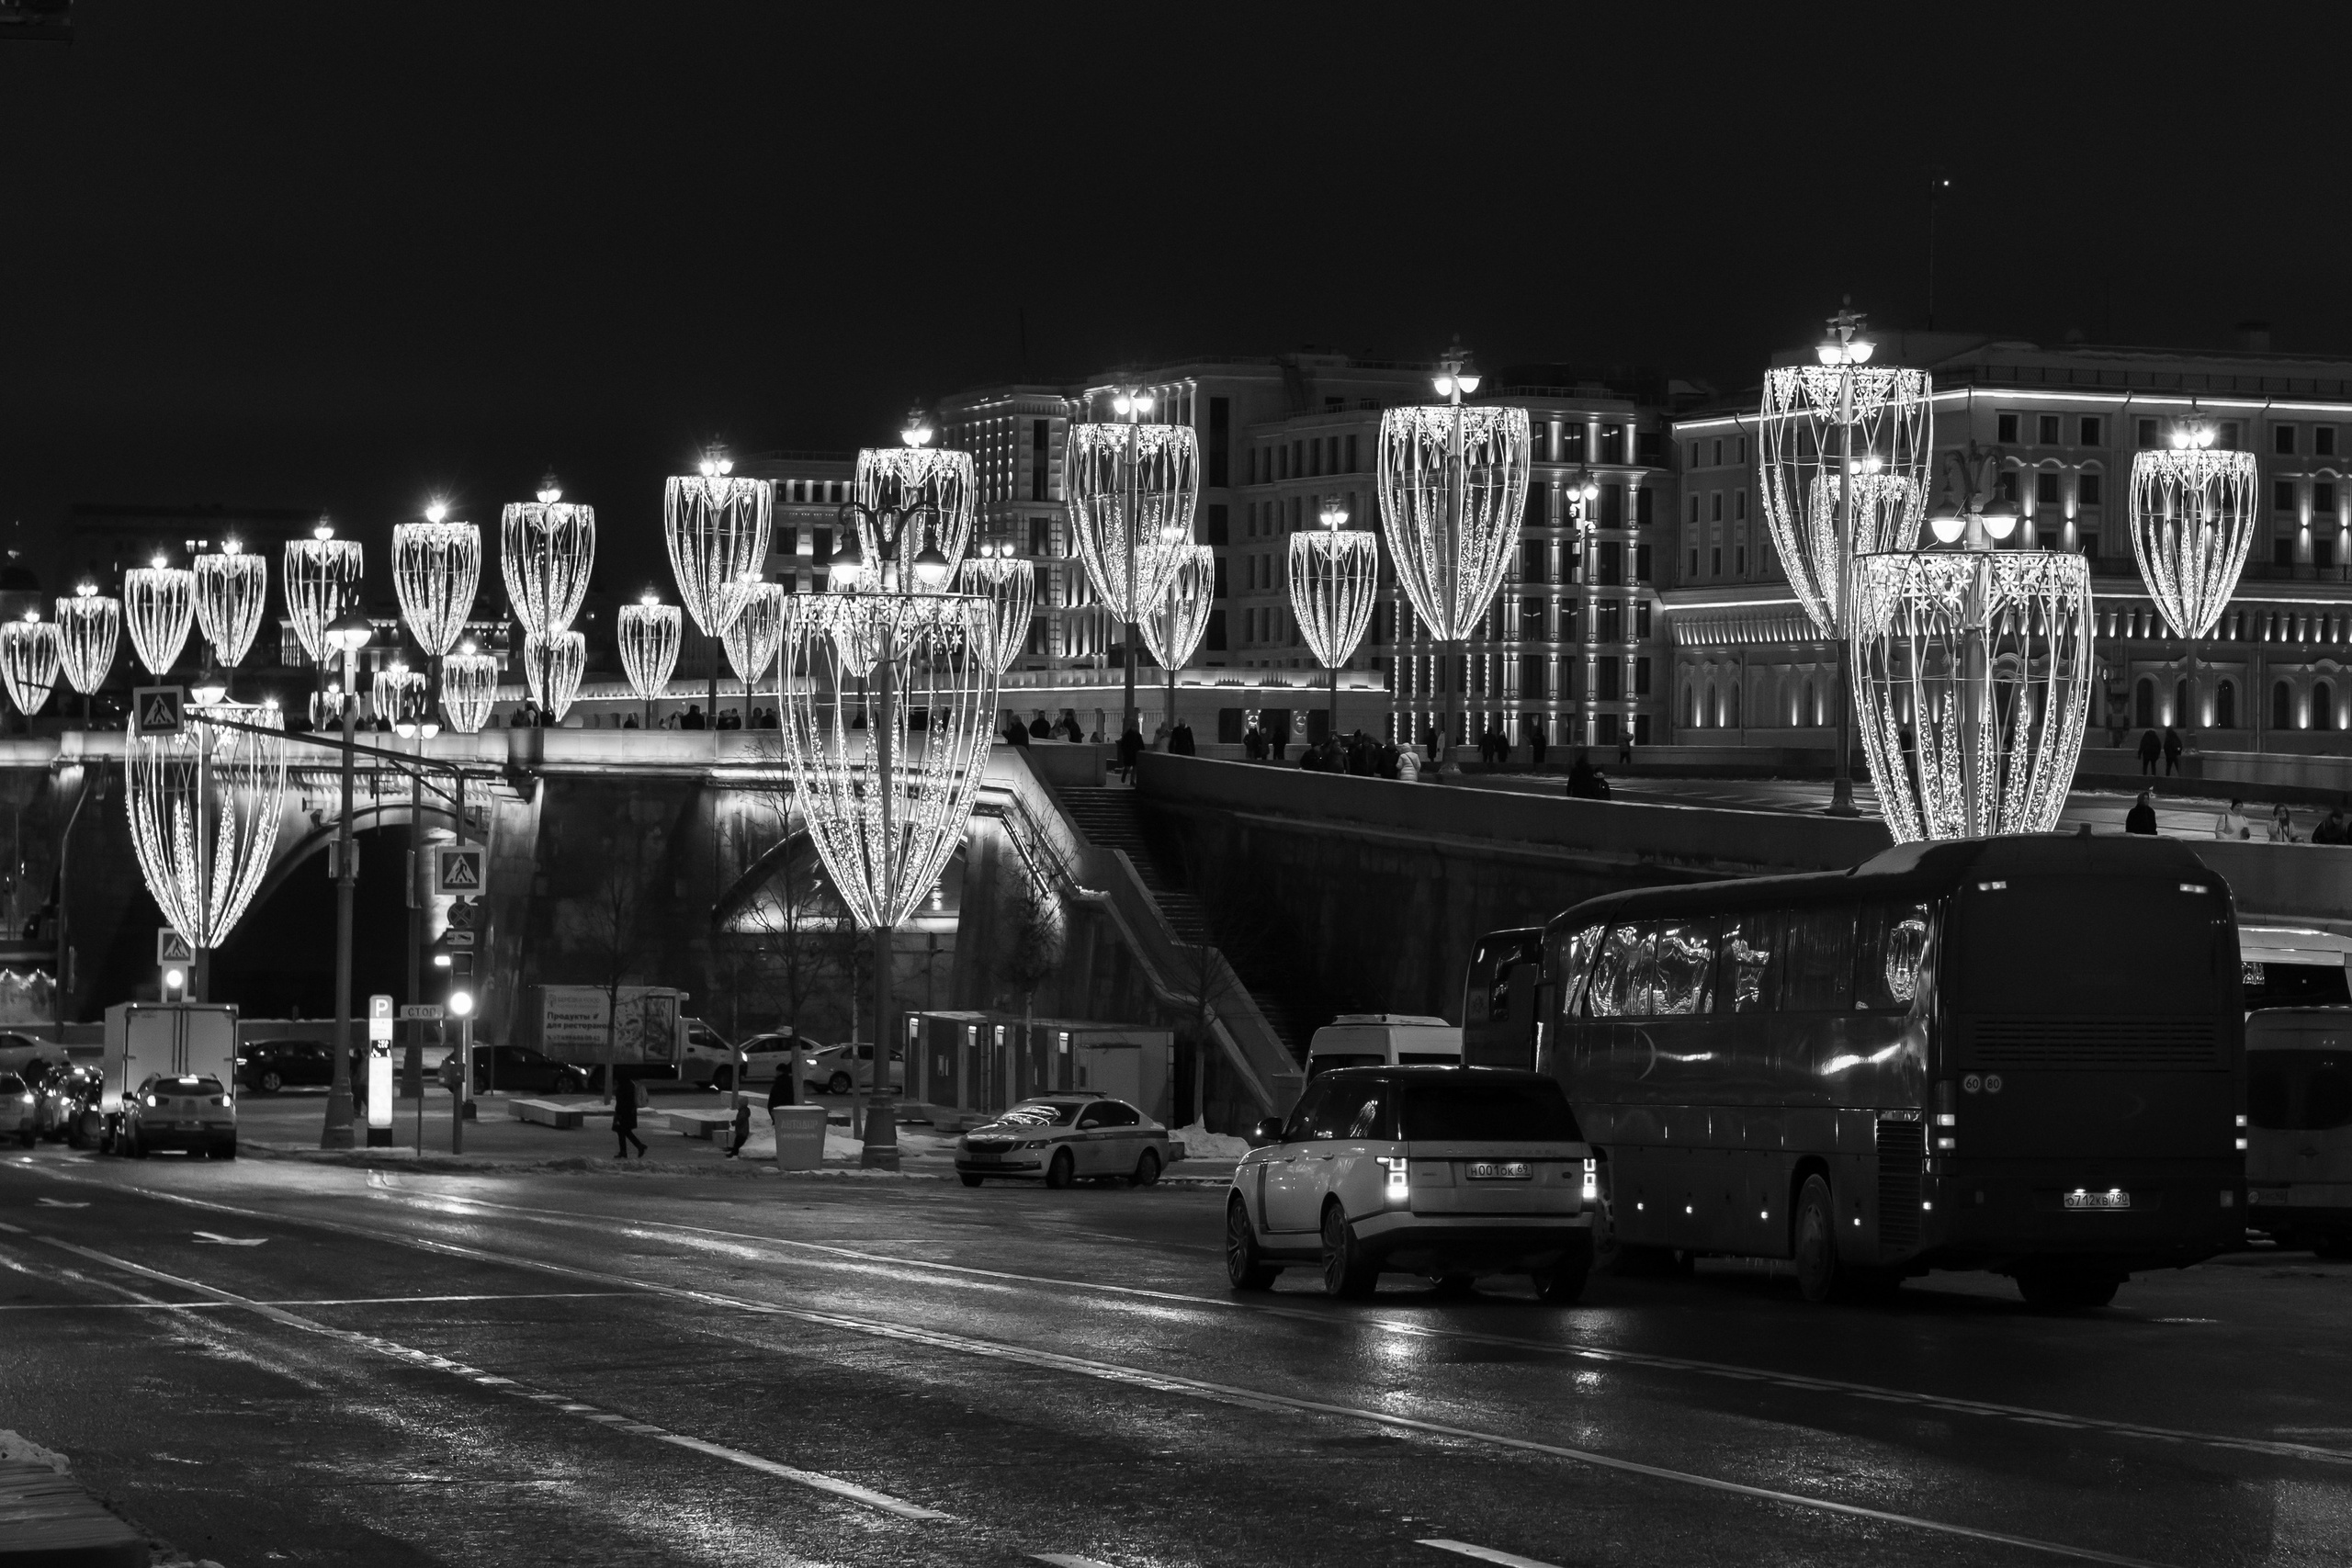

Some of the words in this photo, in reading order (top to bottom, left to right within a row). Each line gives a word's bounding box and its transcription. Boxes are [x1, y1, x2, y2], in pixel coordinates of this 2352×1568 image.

[376, 998, 389, 1018] P
[408, 1007, 436, 1017] СТОП
[547, 1011, 590, 1021] Продукты
[1966, 1077, 1979, 1089] 60
[1986, 1078, 2000, 1089] 80
